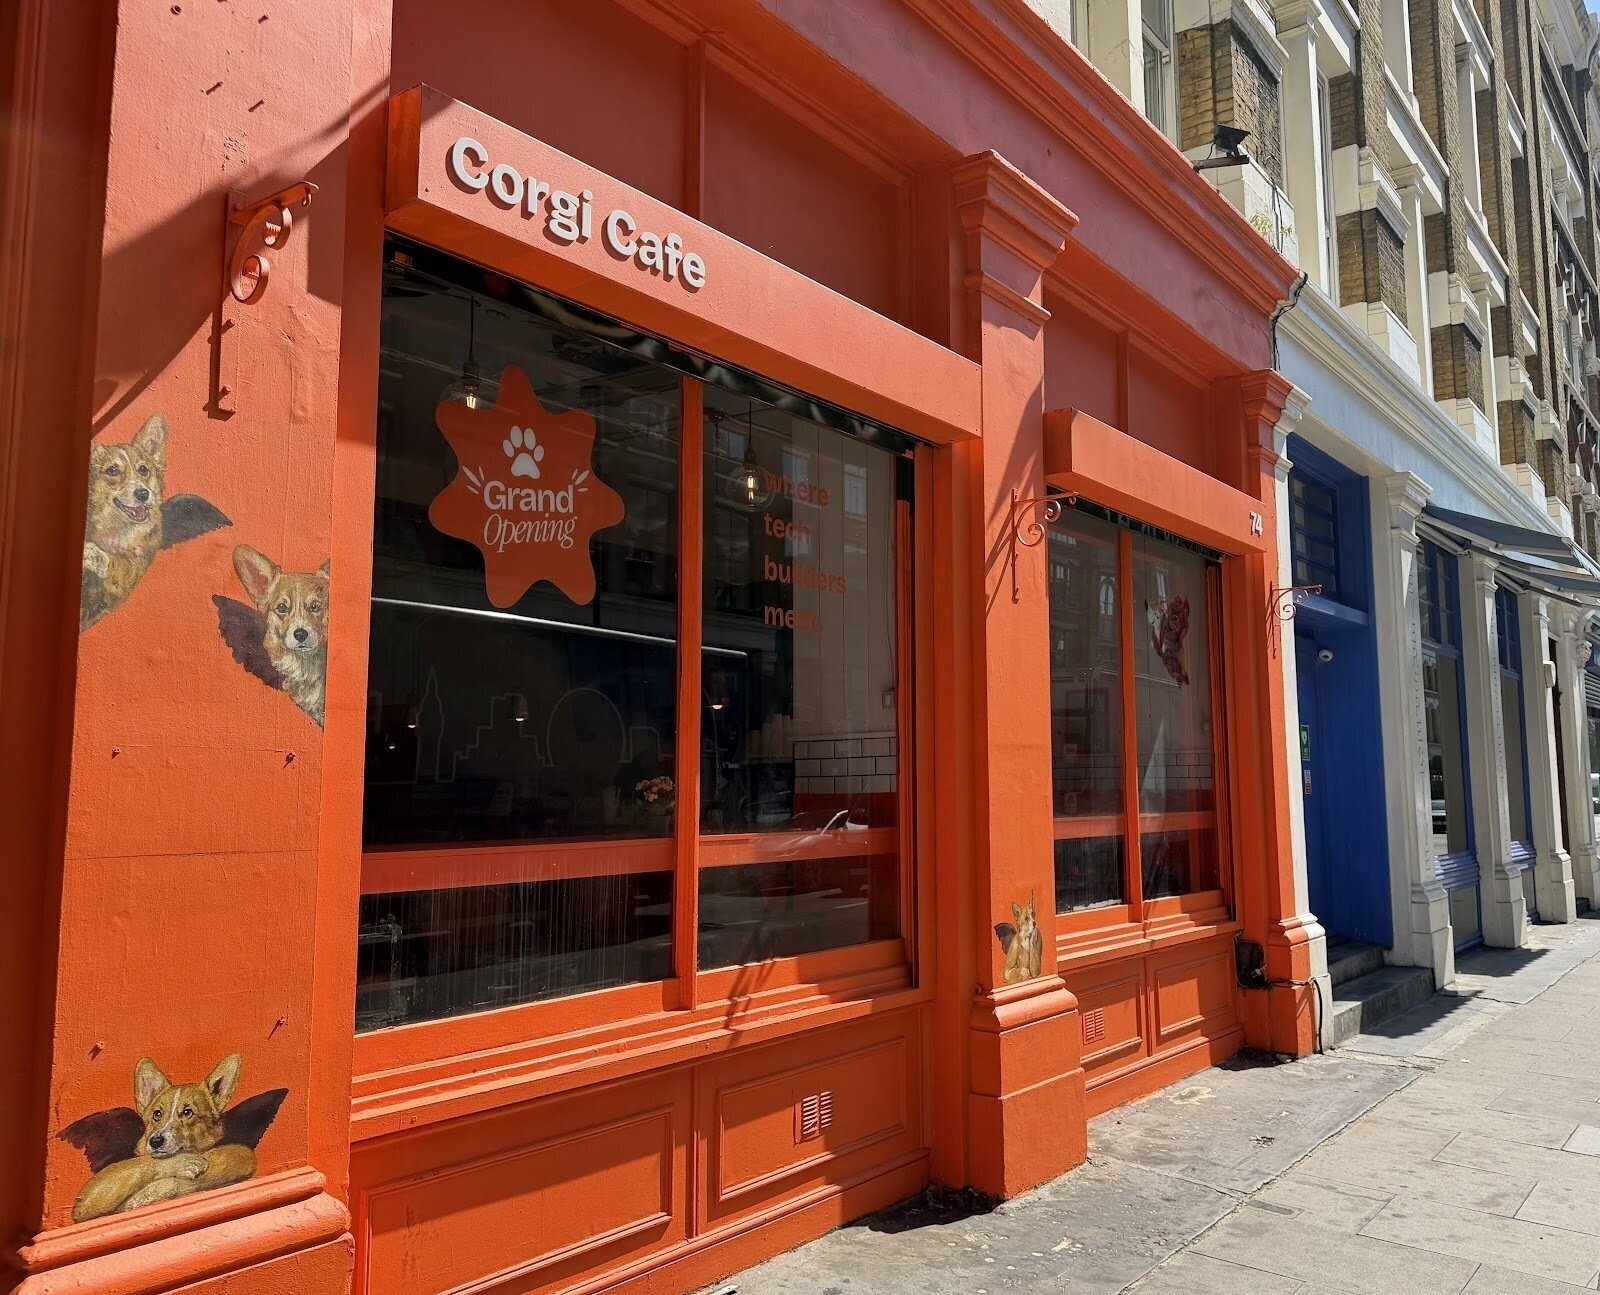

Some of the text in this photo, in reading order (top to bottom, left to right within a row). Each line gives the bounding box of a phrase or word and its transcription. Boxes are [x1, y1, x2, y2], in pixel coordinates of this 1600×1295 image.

[449, 136, 706, 290] Corgi Cafe
[483, 480, 574, 513] Grand
[483, 513, 577, 553] Opening
[763, 512, 811, 544] tech
[1250, 511, 1263, 536] 74
[764, 554, 846, 595] buers
[764, 605, 824, 632] me.
